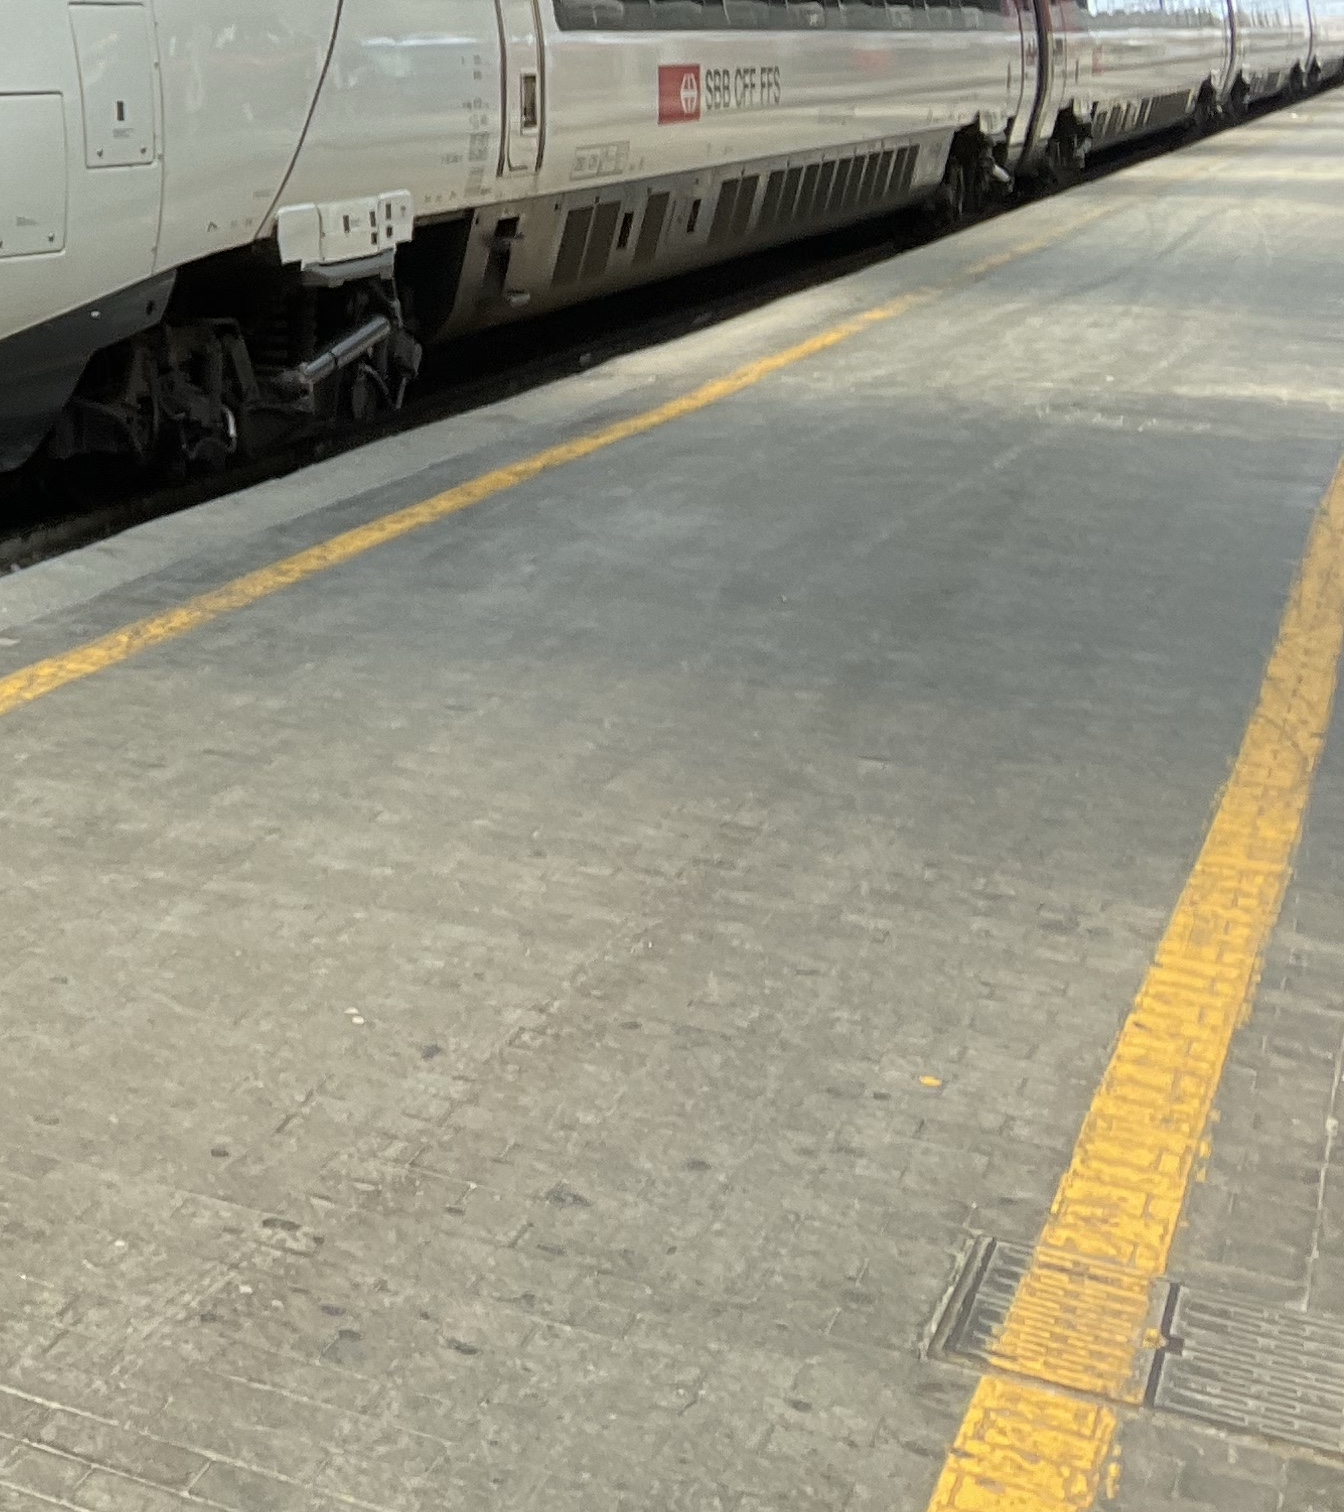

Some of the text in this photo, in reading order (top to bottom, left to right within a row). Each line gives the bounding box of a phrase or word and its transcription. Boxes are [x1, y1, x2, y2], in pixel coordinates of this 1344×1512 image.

[705, 65, 781, 110] SBB CFF FFS
